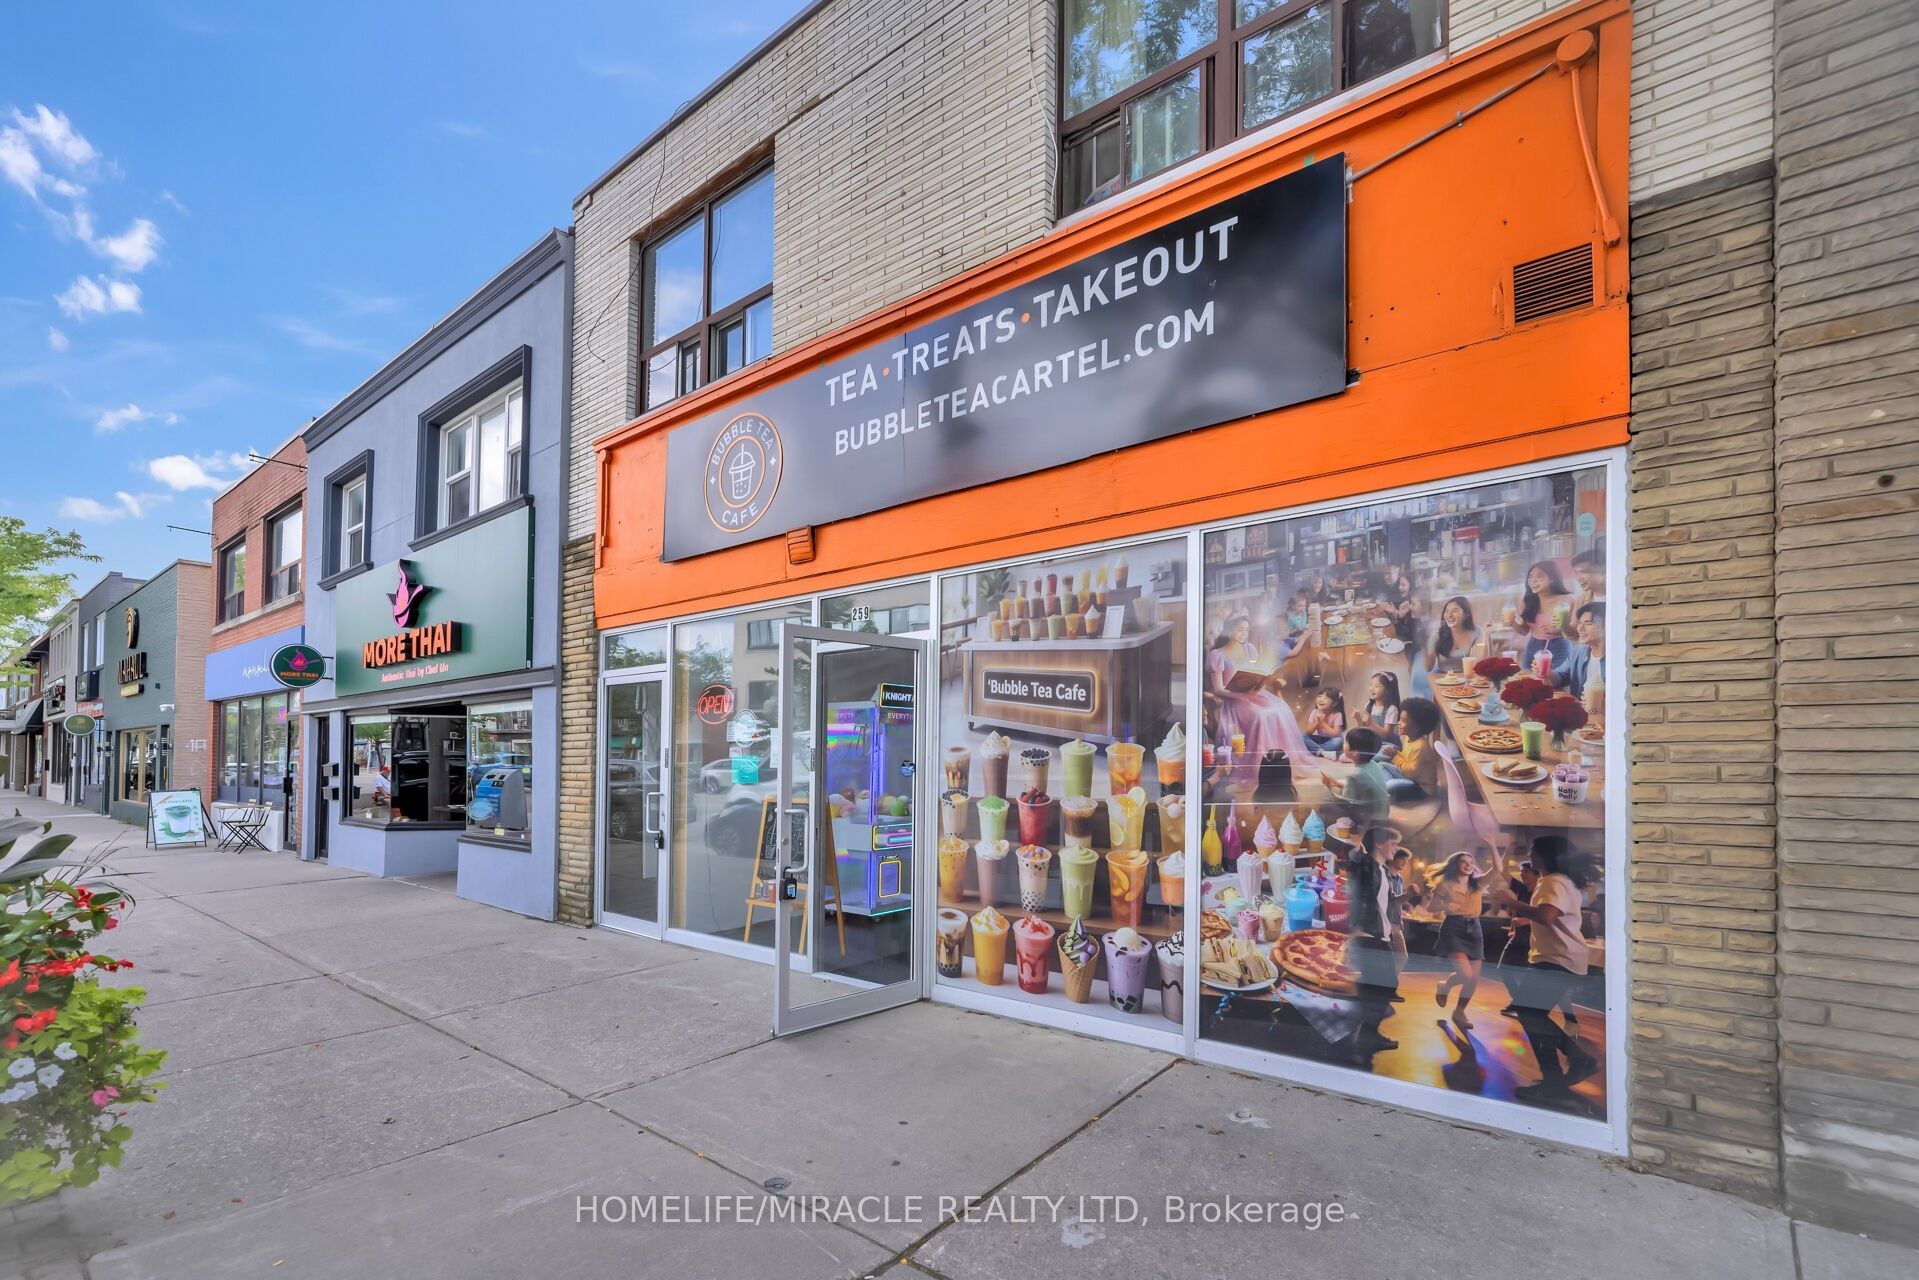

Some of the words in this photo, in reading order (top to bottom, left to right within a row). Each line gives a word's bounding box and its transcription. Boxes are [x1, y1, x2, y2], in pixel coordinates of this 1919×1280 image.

[826, 363, 878, 407] TEA
[892, 307, 1016, 381] TREATS
[1033, 216, 1238, 328] TAKEOUT
[835, 301, 1214, 455] BUBBLETEACARTEL.COM
[711, 419, 754, 465] BUBBLE
[757, 421, 775, 450] TEA
[722, 501, 759, 526] CAFE
[852, 606, 869, 621] 259
[363, 633, 406, 669] MORE
[409, 620, 453, 659] THAI
[700, 695, 731, 715] OPEN
[1031, 682, 1053, 699] Tea
[1055, 683, 1087, 702] Cafe
